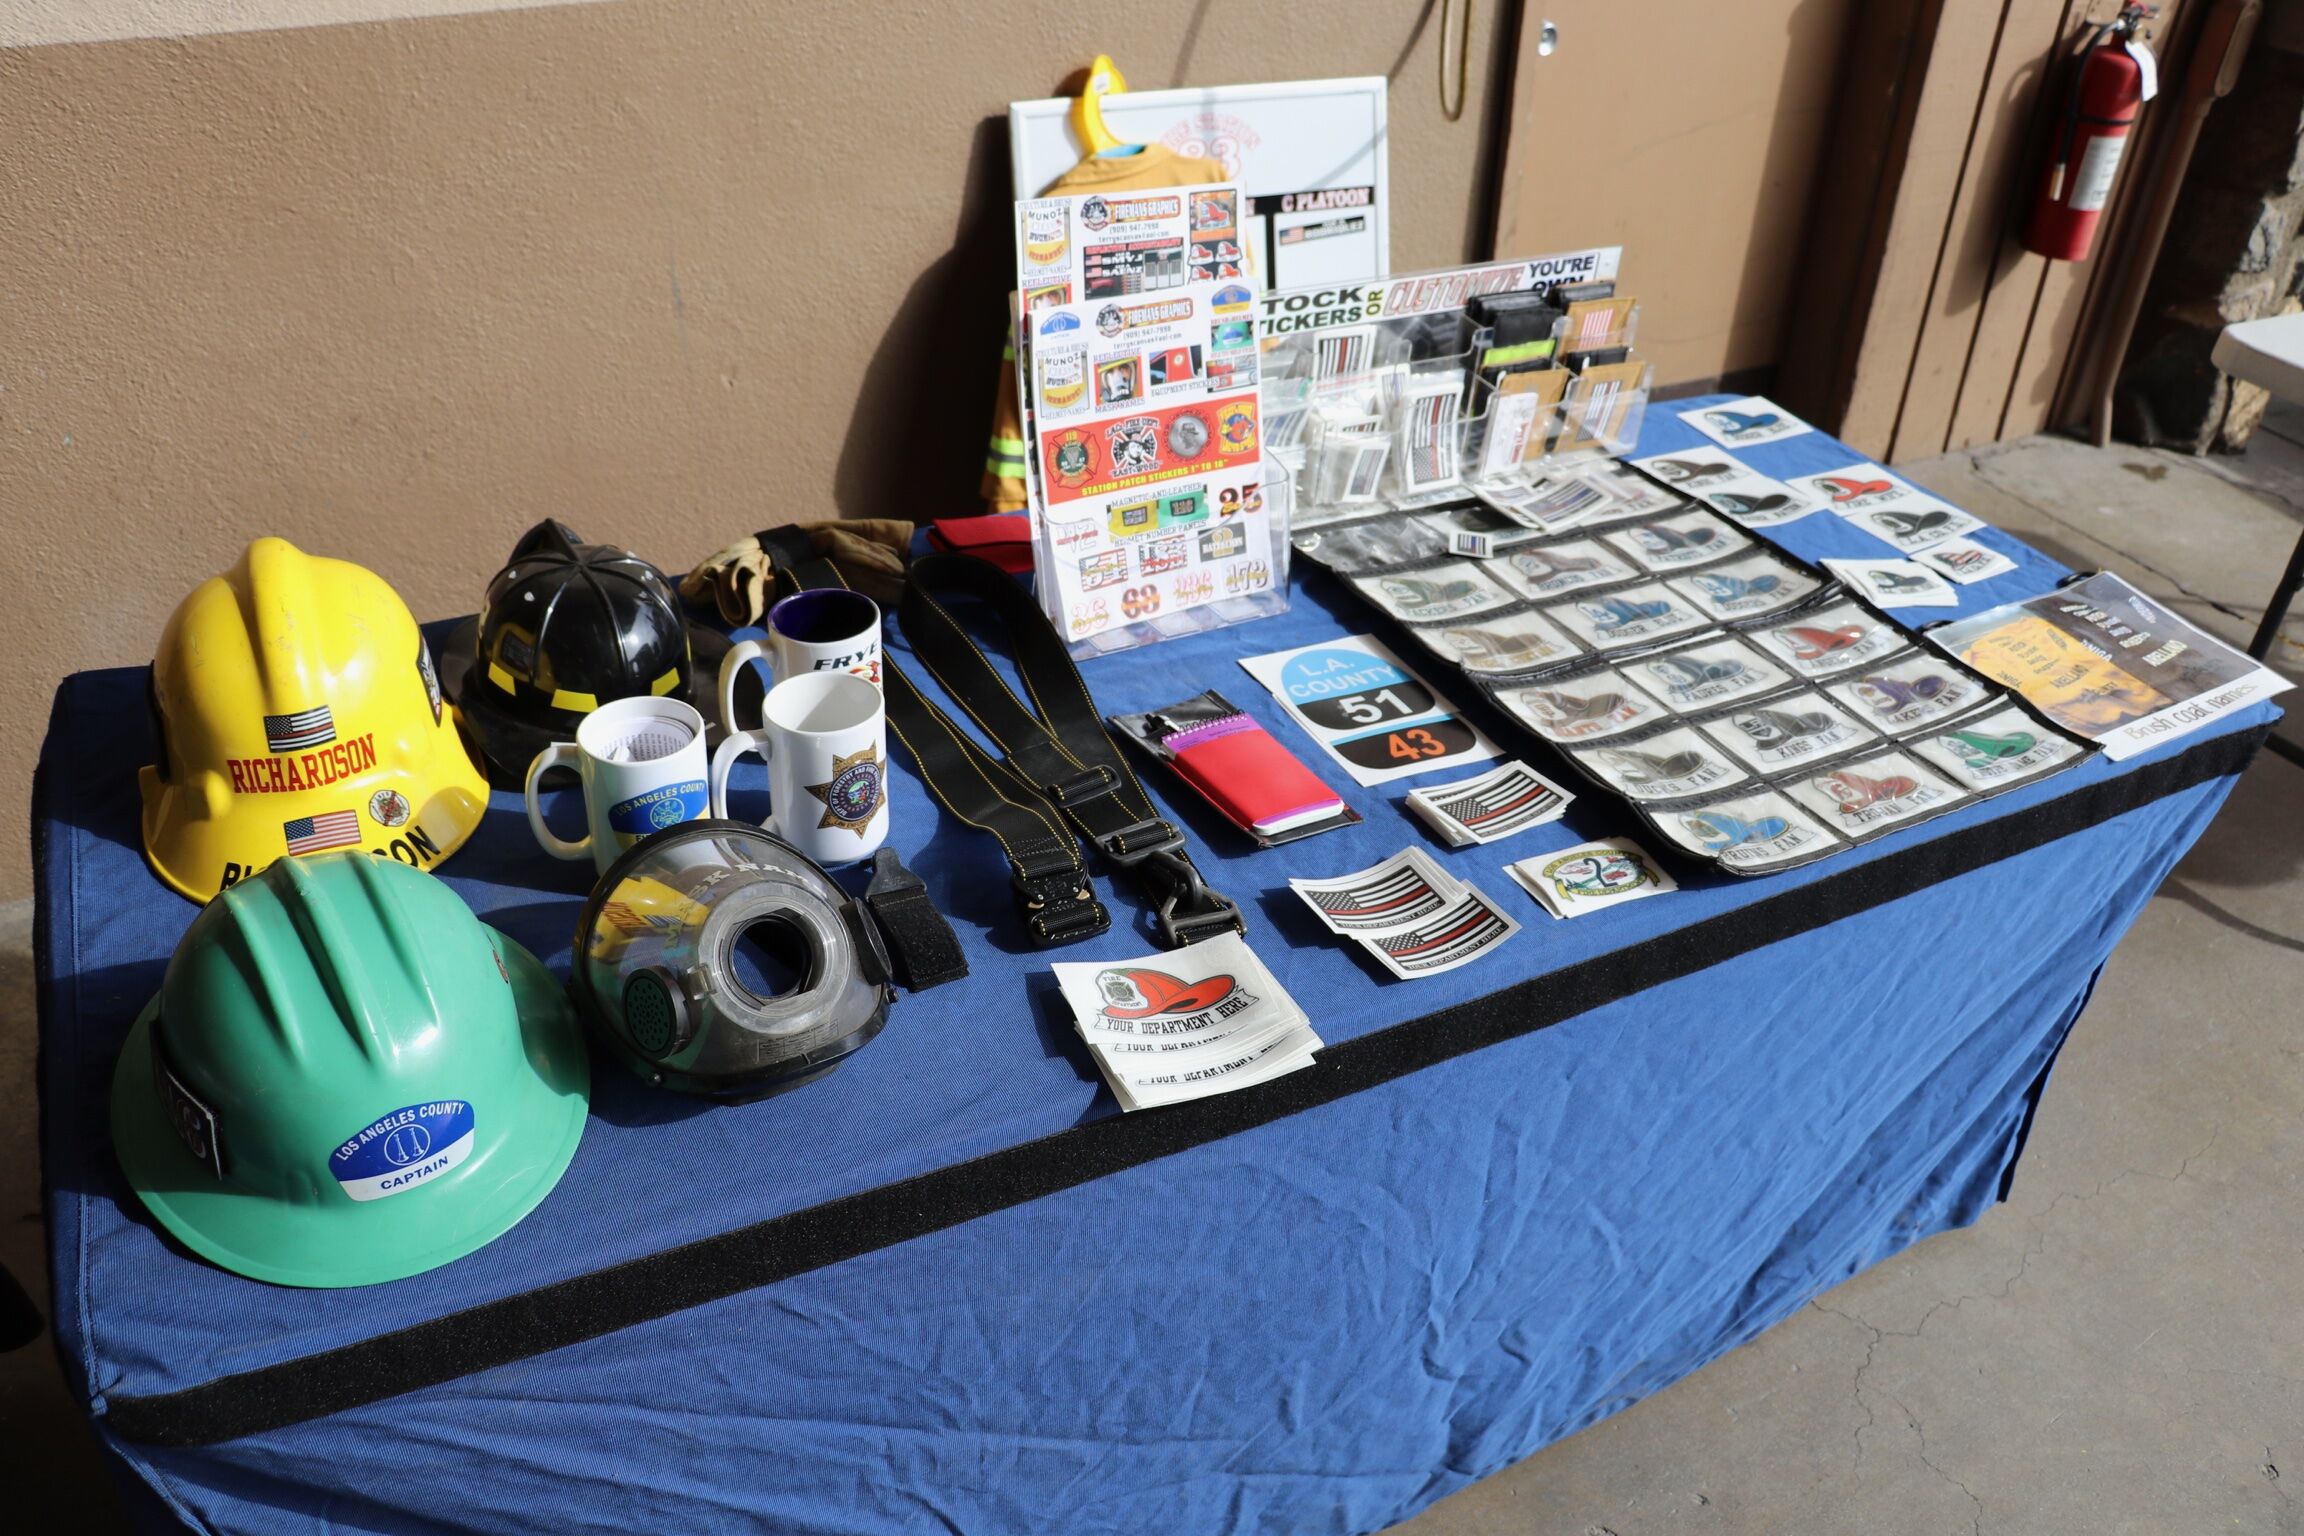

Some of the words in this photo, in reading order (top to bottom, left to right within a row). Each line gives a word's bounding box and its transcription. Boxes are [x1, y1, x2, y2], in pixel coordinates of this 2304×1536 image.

[1028, 208, 1064, 220] MUNOZ
[1281, 195, 1294, 212] C
[1296, 188, 1369, 210] PLATOON
[1260, 286, 1364, 314] TOCK
[1383, 266, 1525, 316] CUSTOMIZE
[1260, 306, 1362, 336] TICKERS
[1045, 353, 1080, 366] MUNOZ
[1189, 378, 1218, 390] STICKERS
[1081, 482, 1118, 496] STATION
[1119, 476, 1147, 489] PATCH
[1148, 467, 1189, 483] STICKERS
[1201, 462, 1212, 472] TO
[1112, 492, 1150, 507] MAGNETIC
[1152, 488, 1168, 500] AND
[1169, 483, 1203, 496] LEATHER
[1148, 528, 1178, 541] NUMBER
[1180, 520, 1207, 533] PANELS
[813, 638, 878, 671] FRYE
[1298, 657, 1355, 677] L.A.
[1289, 664, 1396, 698] COUNTY
[1684, 684, 1729, 702] PADRES
[1733, 674, 1757, 688] FAN
[1339, 688, 1414, 724] 51
[1936, 690, 1961, 708] FAN
[2124, 718, 2174, 741] Brush
[2173, 702, 2212, 724] coat
[1388, 728, 1447, 760] 43
[1777, 738, 1813, 759] KINGS
[1819, 731, 1841, 746] FAN
[227, 733, 377, 794] RICHARDSON
[1688, 767, 1718, 786] FAN
[832, 772, 854, 797] FORESTRY
[854, 766, 866, 775] AND
[615, 803, 633, 817] LOS
[634, 788, 678, 809] ANGELES
[680, 782, 706, 795] COUNTY
[1853, 802, 1905, 823] TROJAN
[1775, 834, 1803, 851] FAN
[1364, 913, 1416, 930] DEPARTMENT
[1417, 902, 1440, 917] HERE
[1429, 943, 1479, 968] DEPARTMENT
[1480, 926, 1504, 946] HERE
[1103, 974, 1122, 983] FIRE
[1107, 1018, 1134, 1034] YOUR
[1141, 1012, 1215, 1036] DEPARTMENT
[1215, 996, 1248, 1019] HERE
[335, 1139, 360, 1162] LOS
[359, 1109, 416, 1144] ANGELES
[419, 1102, 465, 1118] COUNTY
[380, 1156, 449, 1190] CAPTAIN
